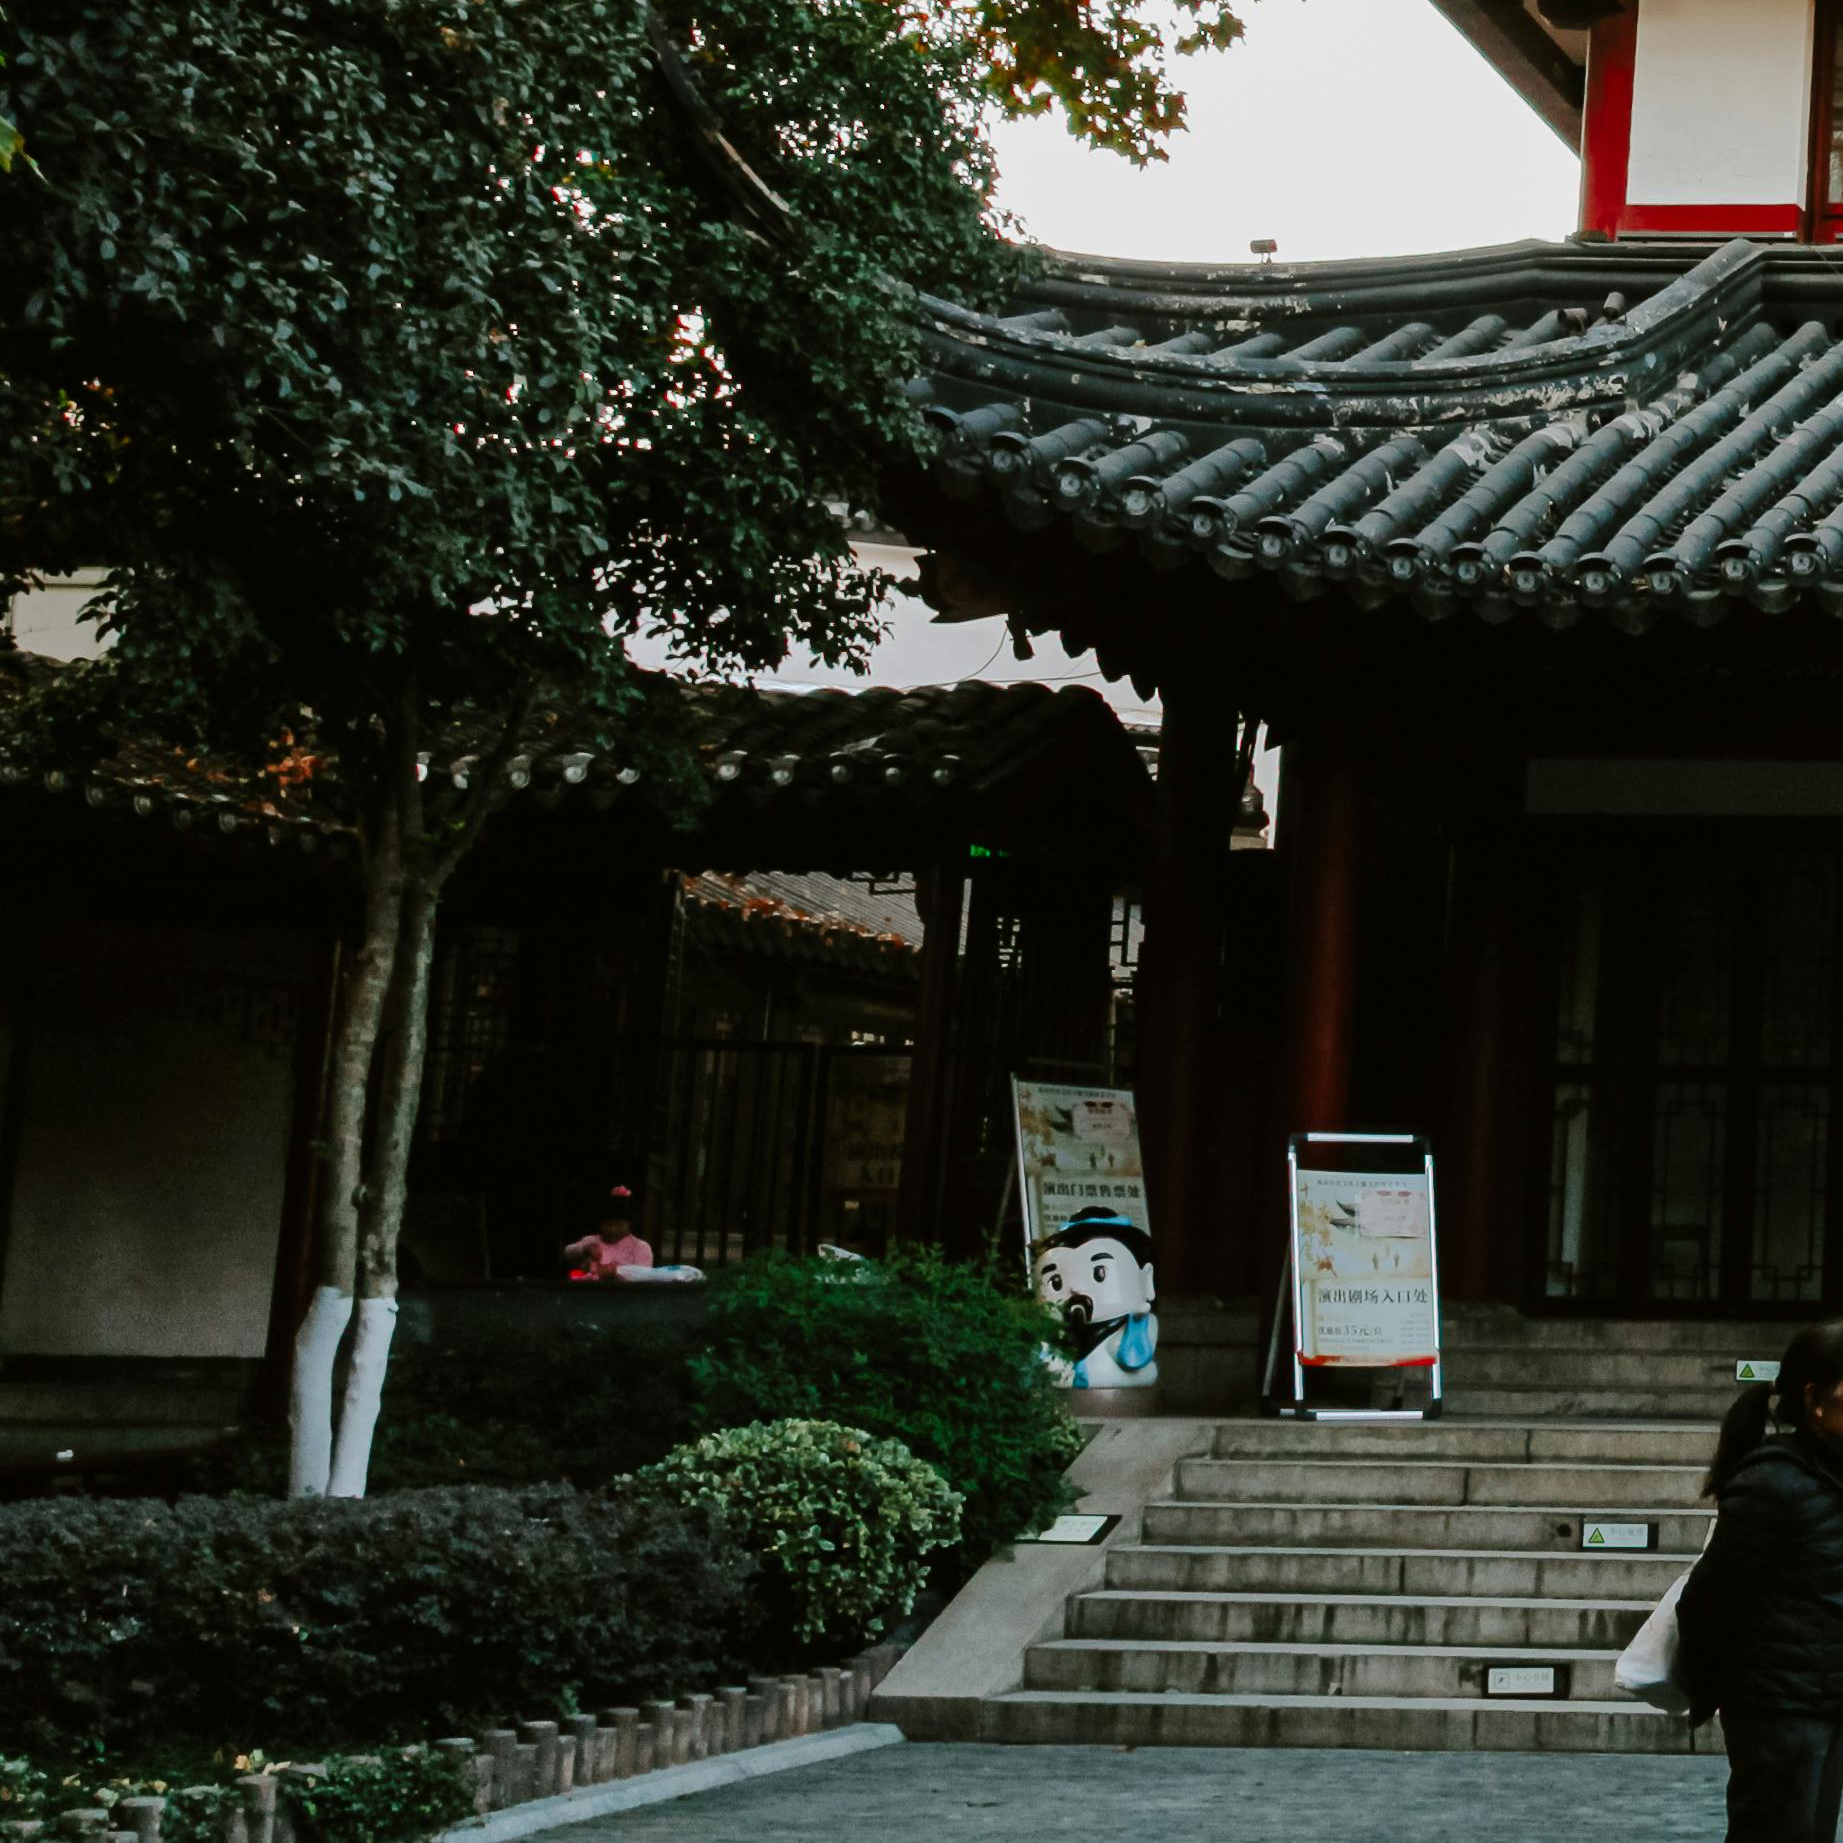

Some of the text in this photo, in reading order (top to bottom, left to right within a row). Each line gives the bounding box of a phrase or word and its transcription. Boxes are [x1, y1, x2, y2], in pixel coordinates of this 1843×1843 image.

[1318, 1288, 1428, 1304] 演出剧场入口处
